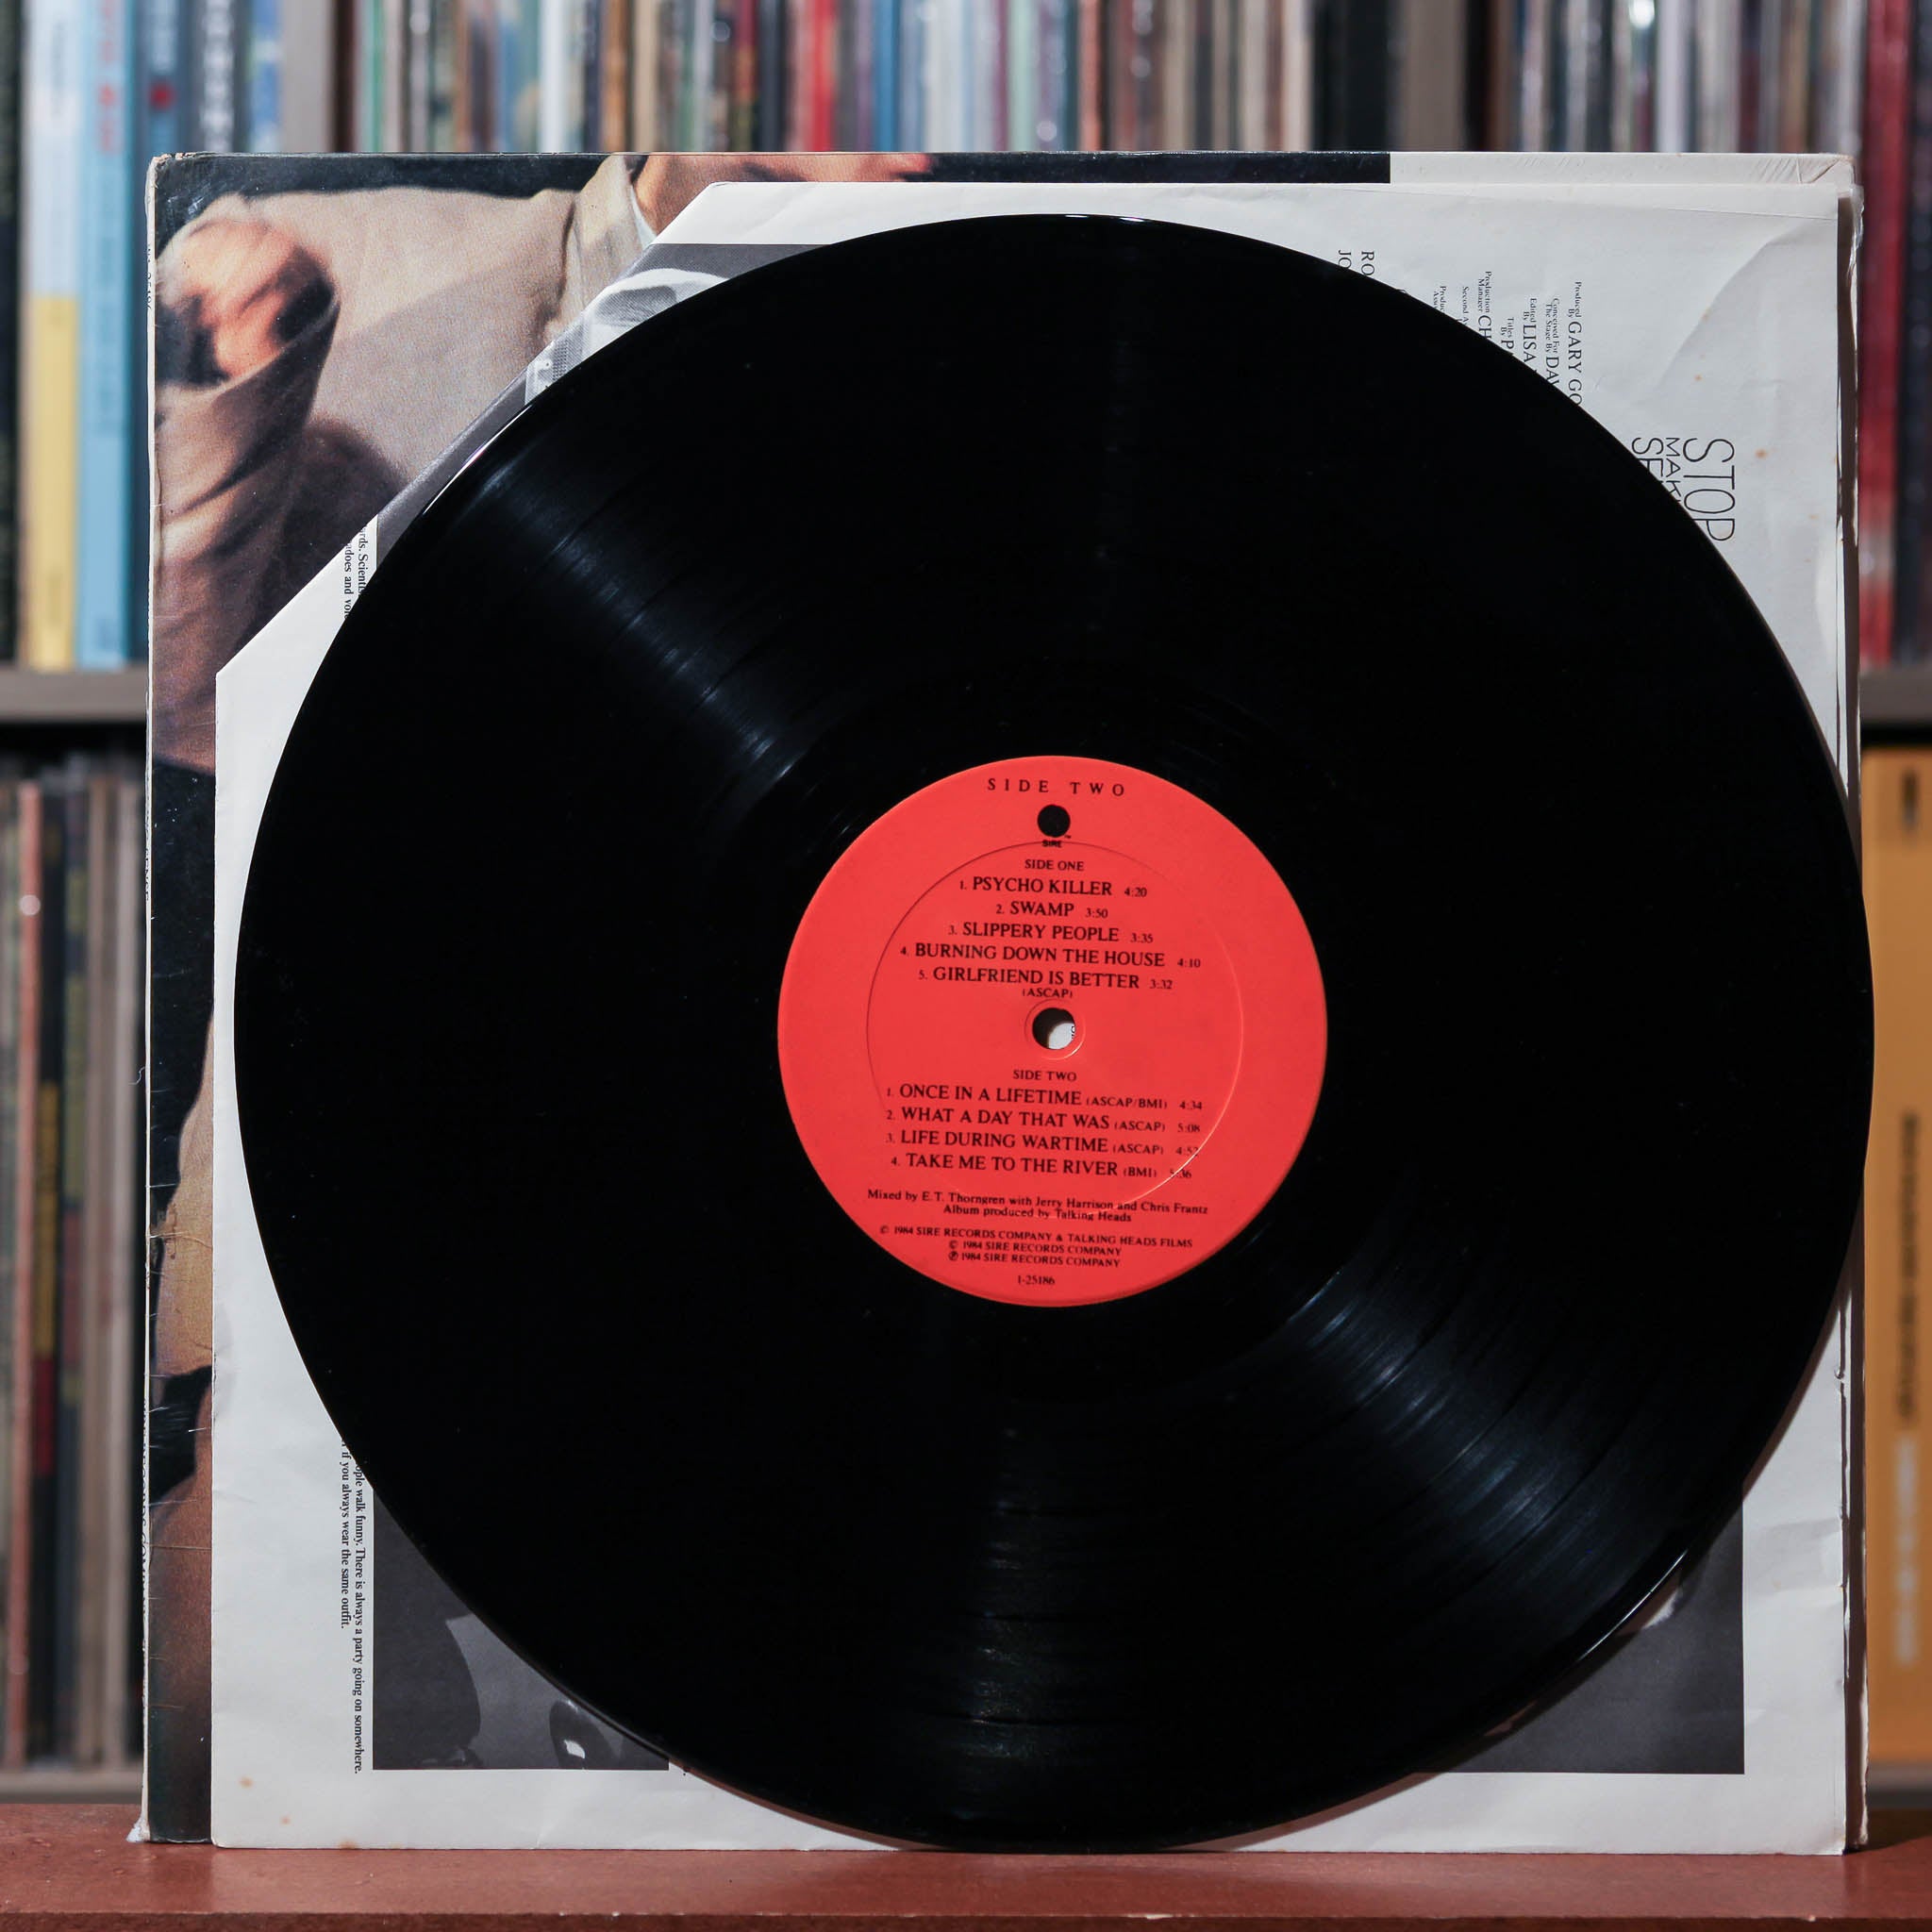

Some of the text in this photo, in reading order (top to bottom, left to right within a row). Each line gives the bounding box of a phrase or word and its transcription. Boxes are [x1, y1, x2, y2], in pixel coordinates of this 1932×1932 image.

[1529, 297, 1538, 323] Edited
[1574, 281, 1583, 318] Produced
[1523, 324, 1538, 363] LISA
[1568, 321, 1583, 374] GARY
[1665, 437, 1681, 502] MAK
[1683, 438, 1735, 541] STOP
[344, 576, 354, 594] and
[988, 778, 1124, 796] SIDE TWO
[1024, 859, 1084, 871] SIDE ONE
[973, 876, 1044, 893] PSYCHO
[1049, 879, 1112, 895] KILLER
[1124, 887, 1147, 897] 4:20
[1010, 901, 1074, 917] SWAMP
[1086, 908, 1108, 919] 3:50
[962, 922, 1046, 939] SLIPPERY
[1052, 925, 1119, 941] PEOPLE
[1131, 933, 1153, 943] 3:35
[915, 942, 996, 959] BURNING
[1003, 946, 1057, 961] DOWN
[1062, 948, 1099, 964] THE
[1105, 951, 1165, 967] HOUSE
[1177, 958, 1201, 968] 4:10
[933, 966, 1043, 984] GIRLFRIEND
[1048, 971, 1064, 985] IS
[1070, 972, 1140, 990] BETTER
[1150, 979, 1173, 990] 3:32
[1013, 1070, 1077, 1082] SIDE TWO
[900, 1083, 949, 1099] ONCE
[955, 1086, 973, 1100] IN
[978, 1088, 991, 1101] A
[996, 1088, 1081, 1105] LIFETIME
[1179, 1101, 1202, 1109] 4:34
[902, 1107, 955, 1123] WHAT
[960, 1109, 972, 1123] A
[977, 1109, 1012, 1124] DAY
[1019, 1111, 1067, 1127] THAT
[1073, 1114, 1109, 1129] WAS
[1178, 1124, 1200, 1132] 5:08
[901, 1129, 940, 1145] LIFE
[944, 1131, 1015, 1148] DURING
[1022, 1135, 1108, 1152] WARTIME
[906, 1153, 953, 1168] TAKE
[958, 1155, 986, 1170] ME
[991, 1157, 1016, 1171] TO
[1021, 1158, 1057, 1173] THE
[1063, 1159, 1117, 1175] RIVER
[868, 1189, 902, 1200] Mixed
[906, 1191, 918, 1202] by
[948, 1192, 1006, 1206] Thorngren
[1008, 1194, 1032, 1206] with
[1036, 1196, 1062, 1209] Jerry
[1067, 1198, 1113, 1209] Harrison
[1117, 1201, 1138, 1211] and
[1141, 1201, 1170, 1212] Chris
[1174, 1203, 1208, 1214] Frantz
[943, 1205, 1132, 1222] Album produced by Talking Heads
[917, 1226, 941, 1236] SIRE
[944, 1227, 996, 1239] RECORDS
[998, 1230, 1053, 1241] COMPANY
[1068, 1233, 1116, 1244] TALKING
[1120, 1236, 1157, 1246] HEADS
[1160, 1238, 1192, 1247] FILMS
[984, 1253, 1008, 1262] SIRE
[1011, 1254, 1063, 1265] RECORDS
[1067, 1257, 1121, 1268] COMPANY
[986, 1241, 1009, 1251] SIRE
[1012, 1242, 1065, 1254] RECORDS
[1068, 1245, 1123, 1257] COMPANY
[341, 1451, 352, 1460] if
[340, 1462, 349, 1481] you
[354, 1463, 365, 1487] ople
[340, 1483, 352, 1518] always
[356, 1490, 366, 1512] walk
[353, 1515, 366, 1546] funny.
[341, 1549, 352, 1566] the
[356, 1547, 366, 1578] There
[356, 1580, 366, 1591] is
[341, 1596, 352, 1629] outfit.
[353, 1592, 366, 1626] always
[352, 1637, 365, 1664] party
[352, 1667, 365, 1696] going
[355, 1698, 362, 1712] on
[354, 1714, 365, 1774] somewhere.
